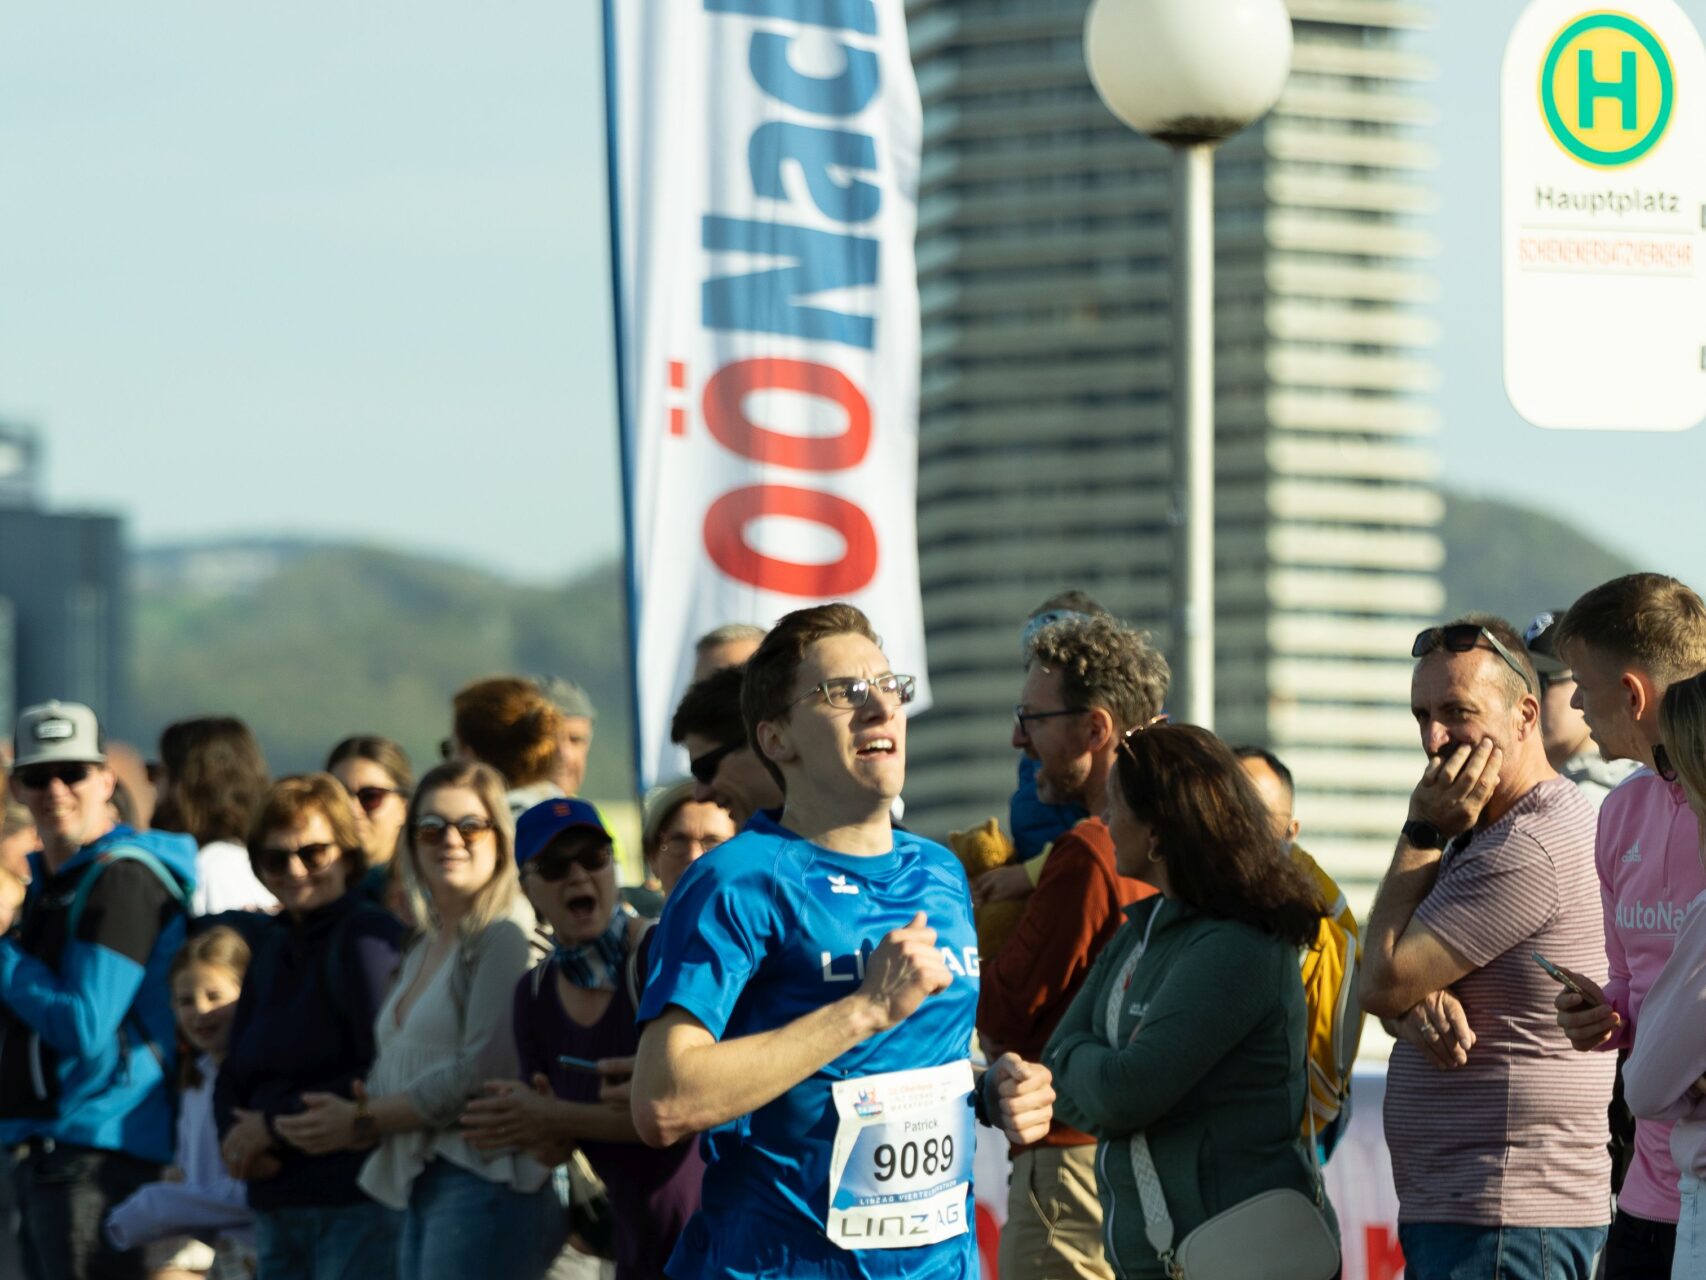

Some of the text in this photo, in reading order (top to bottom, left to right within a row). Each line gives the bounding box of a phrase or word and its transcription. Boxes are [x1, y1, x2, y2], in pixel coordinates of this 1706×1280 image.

[1578, 48, 1638, 131] H
[1535, 186, 1681, 217] Hauptplatz
[1615, 898, 1692, 930] AutoNa
[904, 1119, 939, 1133] Patrick
[873, 1134, 954, 1182] 9089
[937, 1203, 959, 1227] AG
